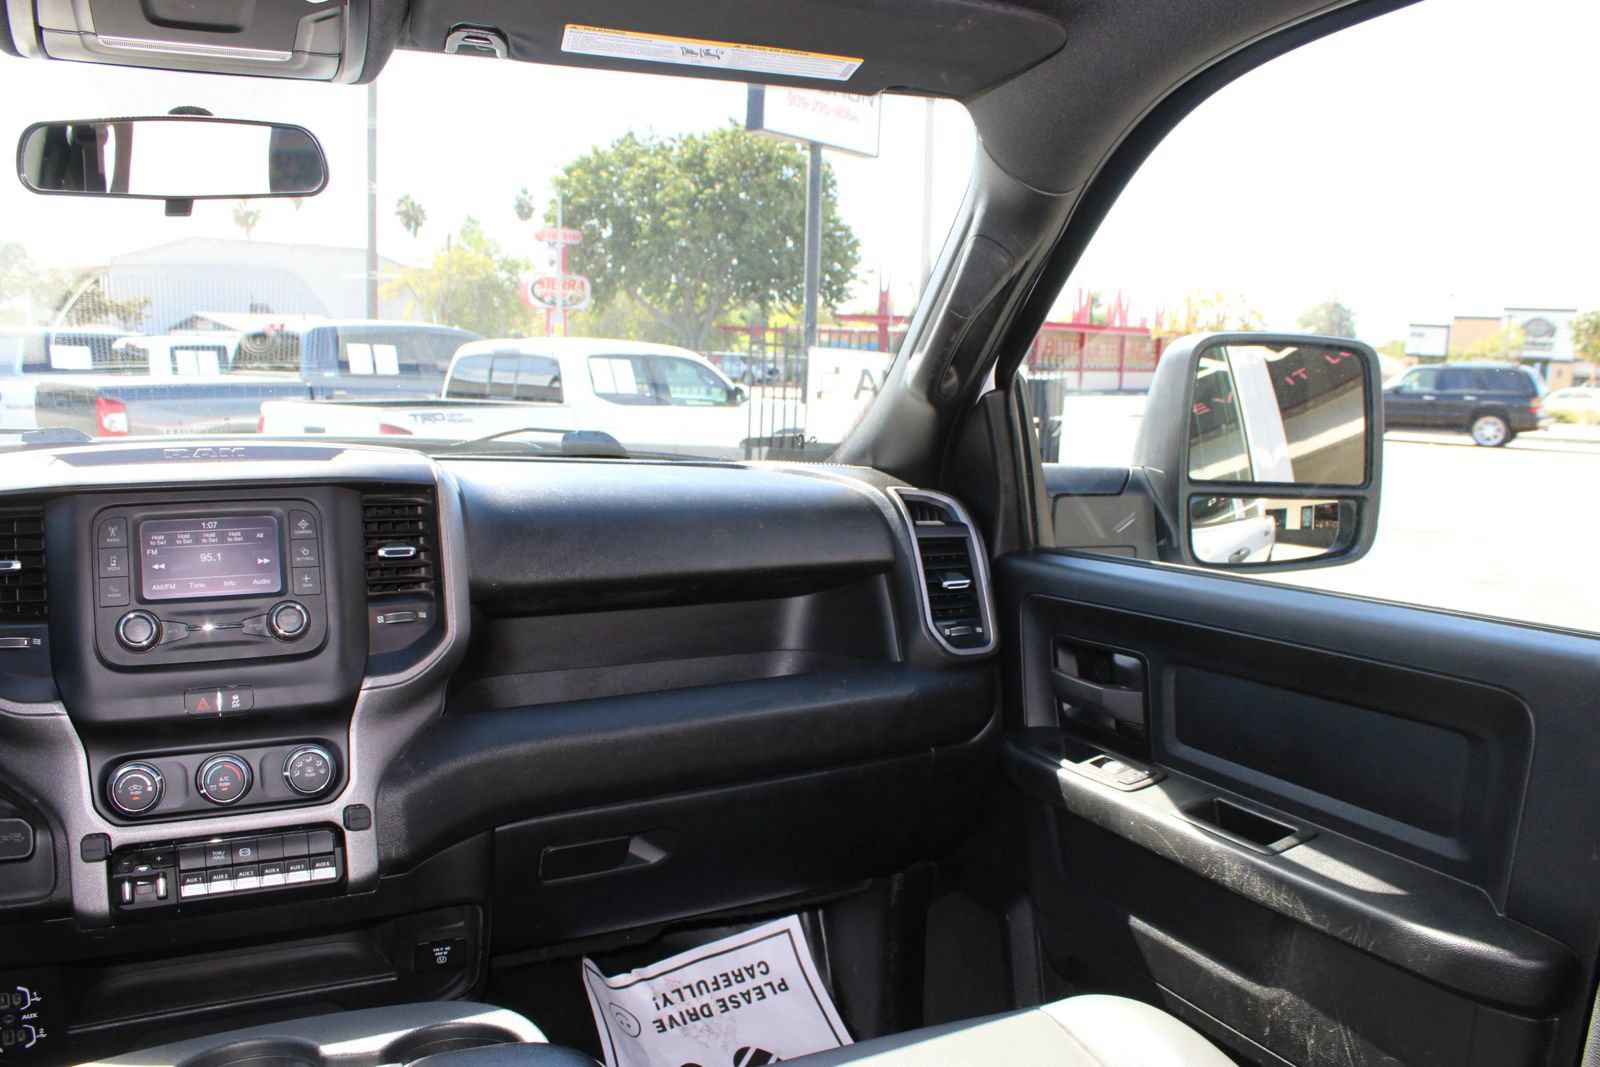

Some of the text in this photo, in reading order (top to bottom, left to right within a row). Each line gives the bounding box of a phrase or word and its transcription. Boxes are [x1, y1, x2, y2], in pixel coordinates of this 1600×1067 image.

[163, 447, 246, 459] RAM
[201, 521, 218, 529] 1:07
[200, 553, 222, 562] 95.1
[152, 583, 176, 591] AM/FM
[653, 960, 770, 1011] CAREFULLY!
[651, 977, 790, 1034] PLEASE DRIVE
